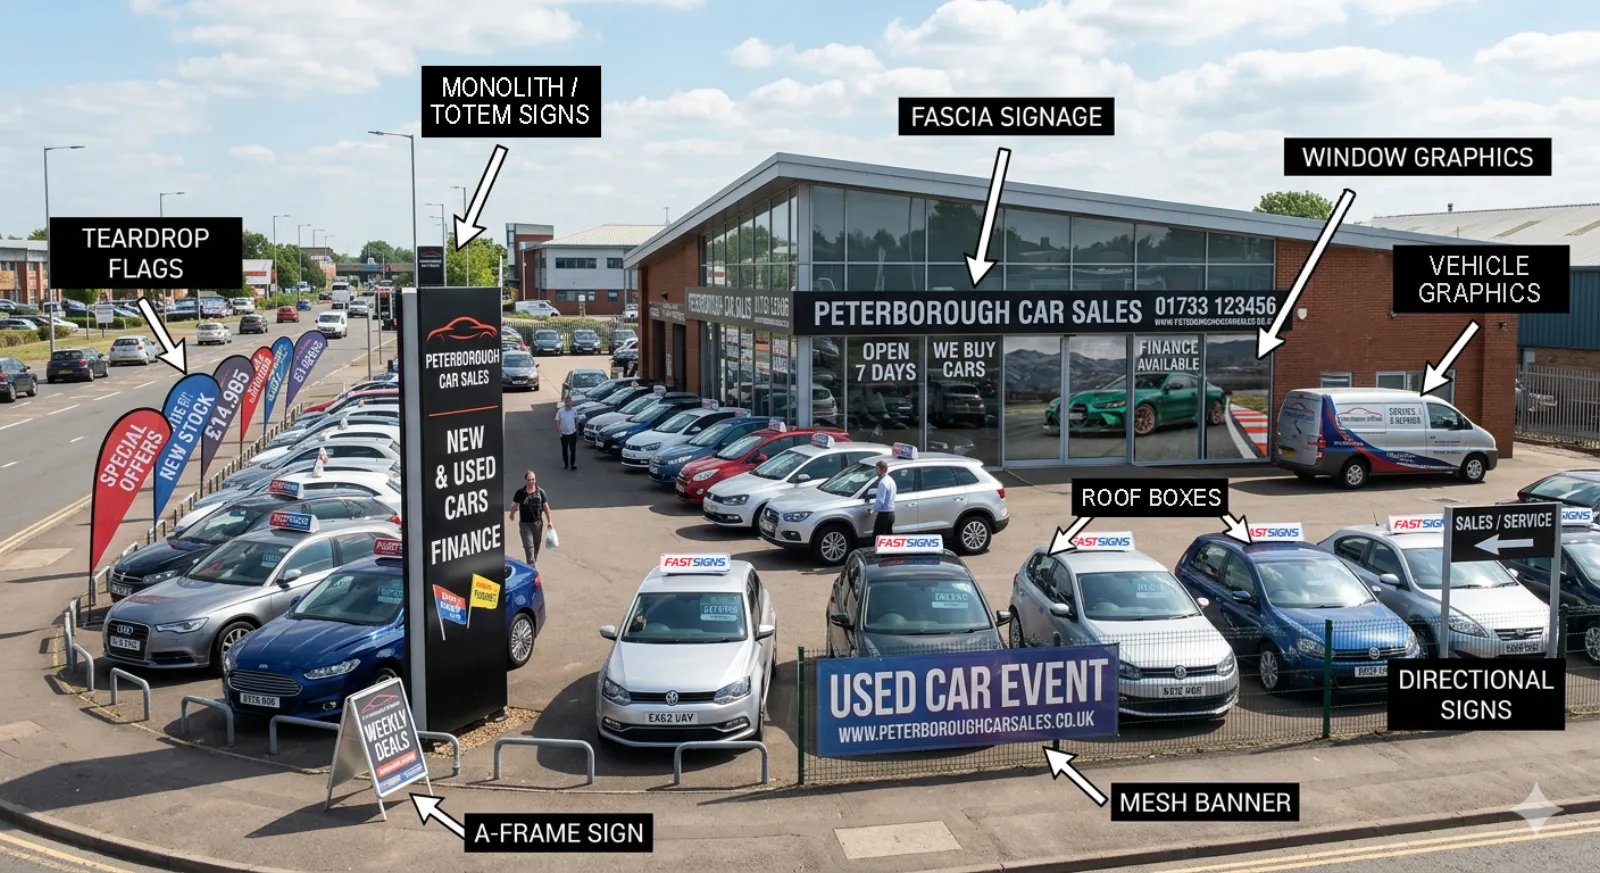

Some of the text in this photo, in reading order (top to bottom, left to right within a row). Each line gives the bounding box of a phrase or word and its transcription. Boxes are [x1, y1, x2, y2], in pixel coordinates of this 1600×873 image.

[814, 299, 1010, 326] PETERBOROUGH
[1018, 299, 1064, 325] CAR
[1072, 299, 1143, 324] SALES
[1155, 296, 1277, 316] 01733 123456
[862, 342, 910, 360] OPEN
[933, 341, 996, 359] WE BUY
[1139, 339, 1199, 355] FINANCE
[425, 348, 500, 369] PETERBOROUGH
[1137, 357, 1200, 371] AVAILABLE
[439, 369, 490, 389] CAR SALES
[855, 363, 917, 382] 7 DAYS
[942, 360, 986, 378] CARS
[159, 442, 187, 482] NEW
[178, 392, 216, 443] STOCK
[446, 425, 485, 454] NEW
[99, 423, 148, 488] SPECIAL
[118, 429, 164, 492] OFFERS
[435, 455, 496, 490] & USED
[444, 488, 489, 520] CARS
[1455, 514, 1493, 531] SALES
[1503, 512, 1552, 529] SERVICE
[431, 523, 501, 566] FINANCE
[877, 538, 940, 548] FASTSIGNS
[664, 557, 726, 567] FASTSIGNS
[829, 657, 1109, 719] USED CAR EVENT
[363, 708, 408, 743] WEEKLY
[648, 713, 673, 723] EX62
[374, 730, 410, 762] DEALS
